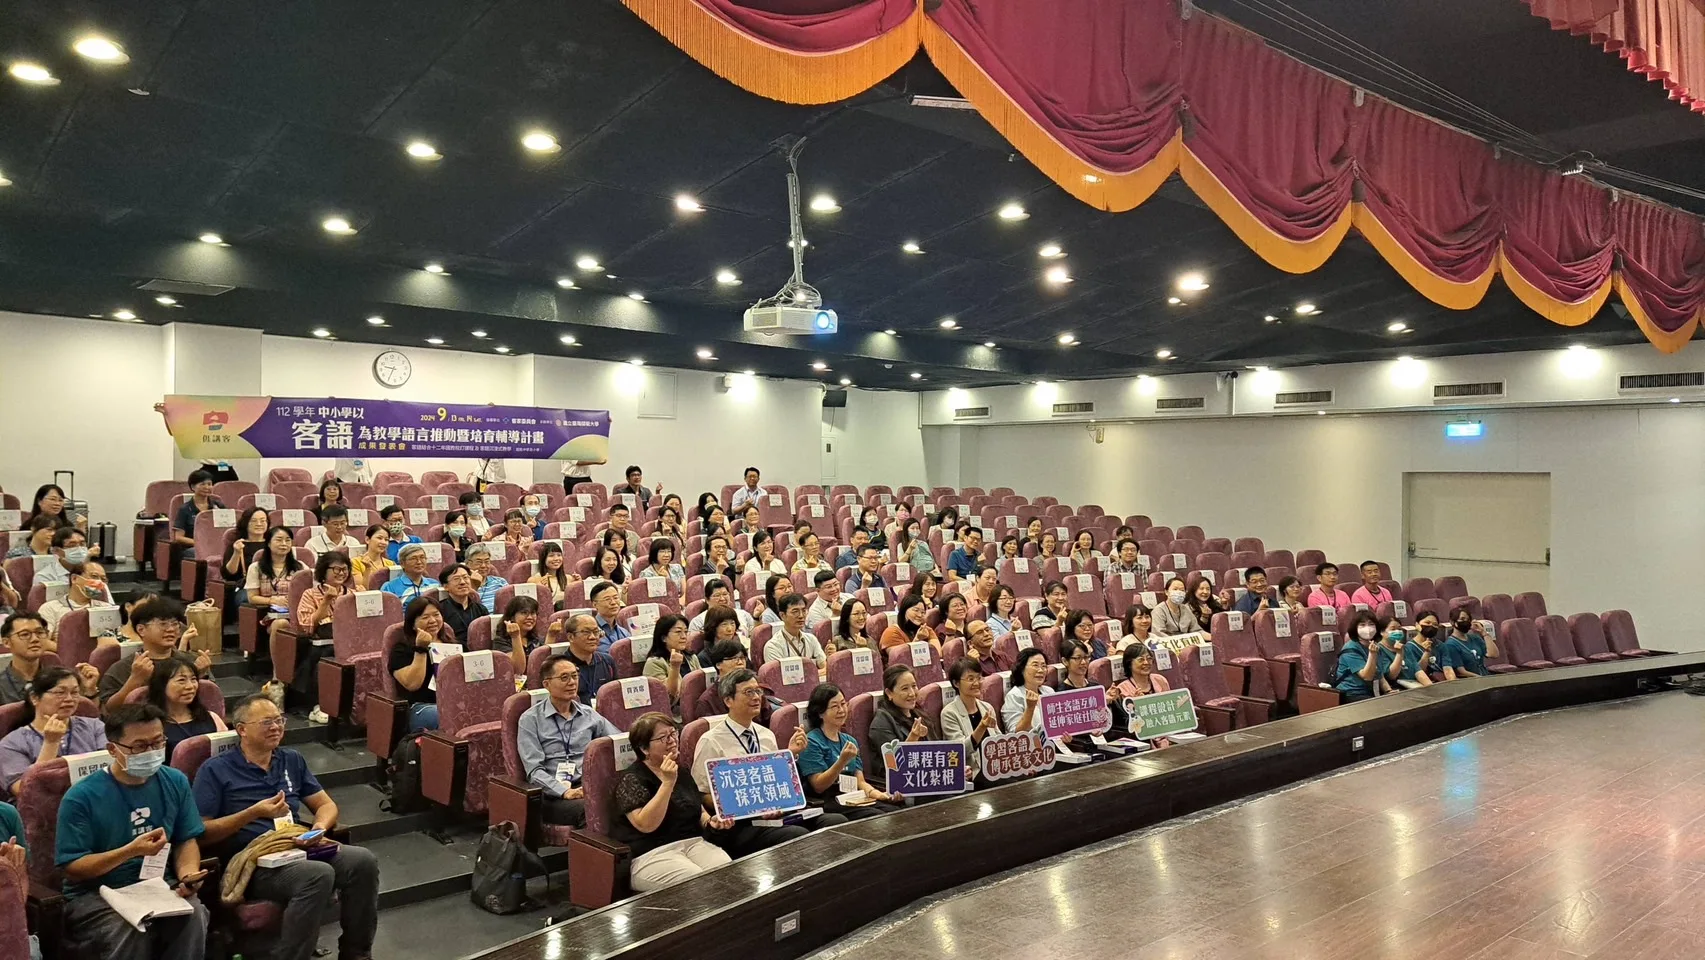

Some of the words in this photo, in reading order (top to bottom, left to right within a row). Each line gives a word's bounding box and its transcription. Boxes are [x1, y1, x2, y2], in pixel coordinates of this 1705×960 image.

[276, 406, 291, 416] 112
[292, 406, 316, 418] 學年
[318, 406, 364, 419] 中小學以
[292, 418, 354, 450] 客語
[358, 426, 544, 444] 為教學語言推動暨培育輔導計畫
[358, 442, 406, 450] 成果發表會
[472, 660, 485, 668] 3-6
[626, 685, 645, 694] 貴賓席
[1046, 696, 1098, 716] 師生客語互動
[1138, 700, 1176, 717] 課程設計
[986, 738, 1028, 759] 學習客語
[907, 750, 959, 768] 課程有客
[990, 748, 1052, 774] 傳承客家文化
[718, 764, 776, 790] 沉浸客語
[902, 769, 954, 788] 文化紮根
[734, 782, 792, 808] 探究領域
